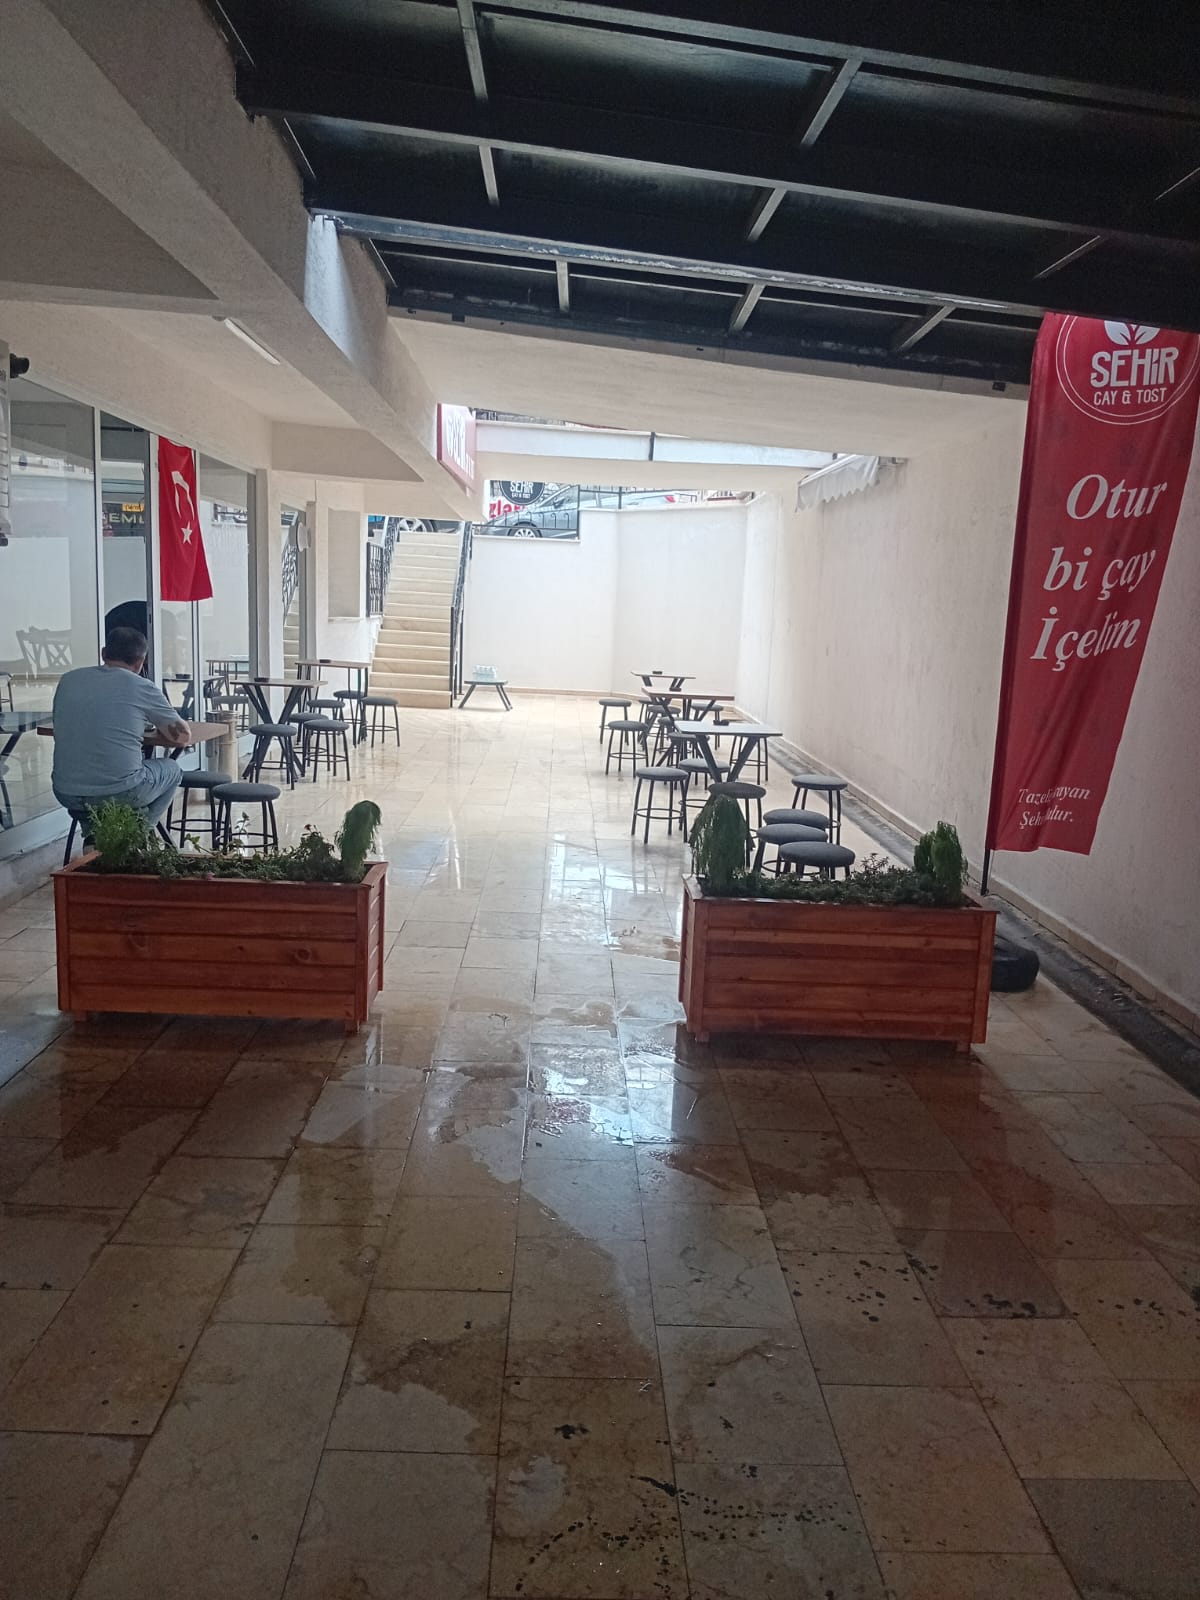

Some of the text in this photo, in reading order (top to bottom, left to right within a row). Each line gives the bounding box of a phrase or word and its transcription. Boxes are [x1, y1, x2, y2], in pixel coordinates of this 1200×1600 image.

[1122, 391, 1131, 405] &
[1136, 387, 1168, 404] TOST
[1066, 474, 1168, 520] Otur
[1043, 546, 1156, 601] bi çay
[1030, 606, 1141, 672] İçelim
